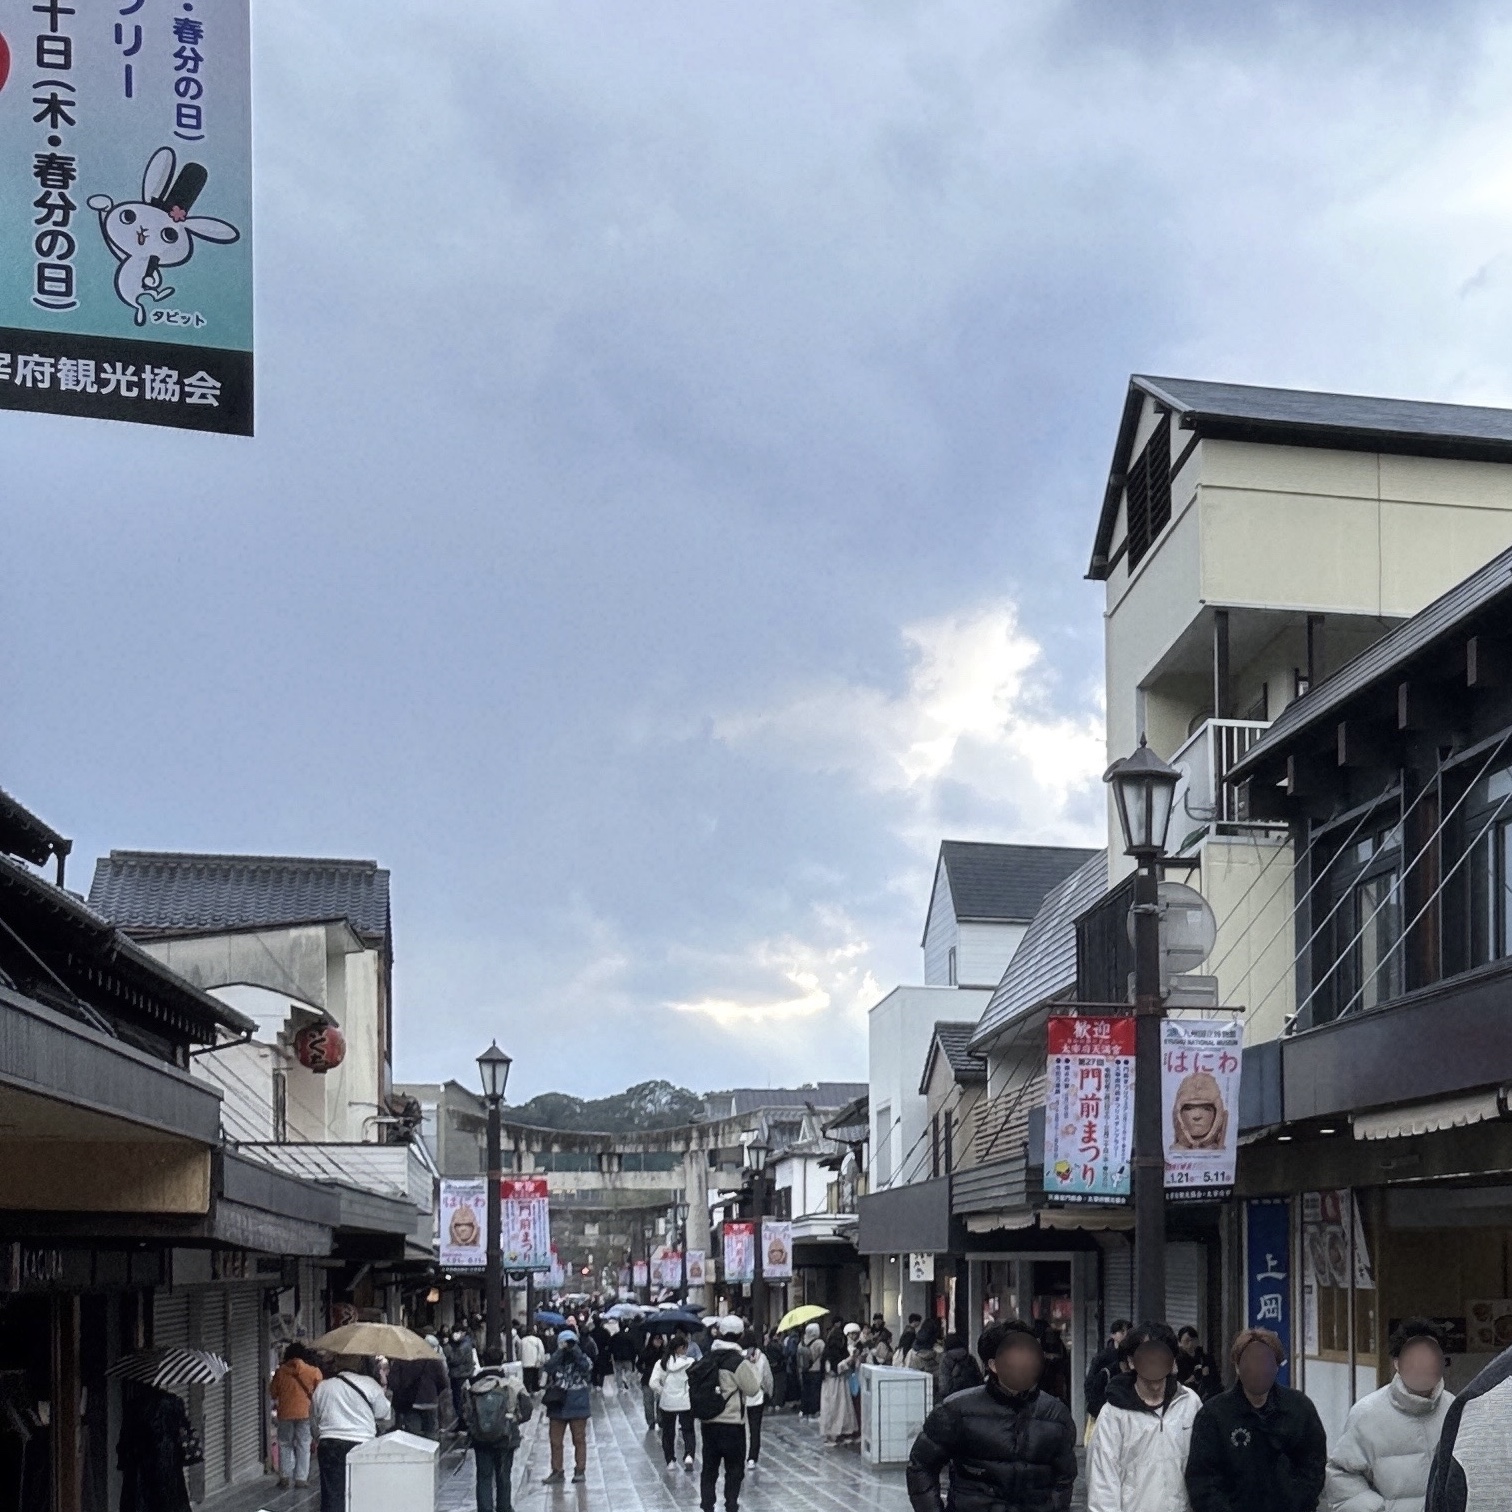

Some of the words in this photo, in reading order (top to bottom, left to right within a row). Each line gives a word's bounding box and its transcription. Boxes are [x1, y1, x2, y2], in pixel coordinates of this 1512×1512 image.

[0, 352, 222, 407] 府観光協会
[1167, 1051, 1238, 1074] はにわ
[1079, 1068, 1102, 1188] 門前まつり
